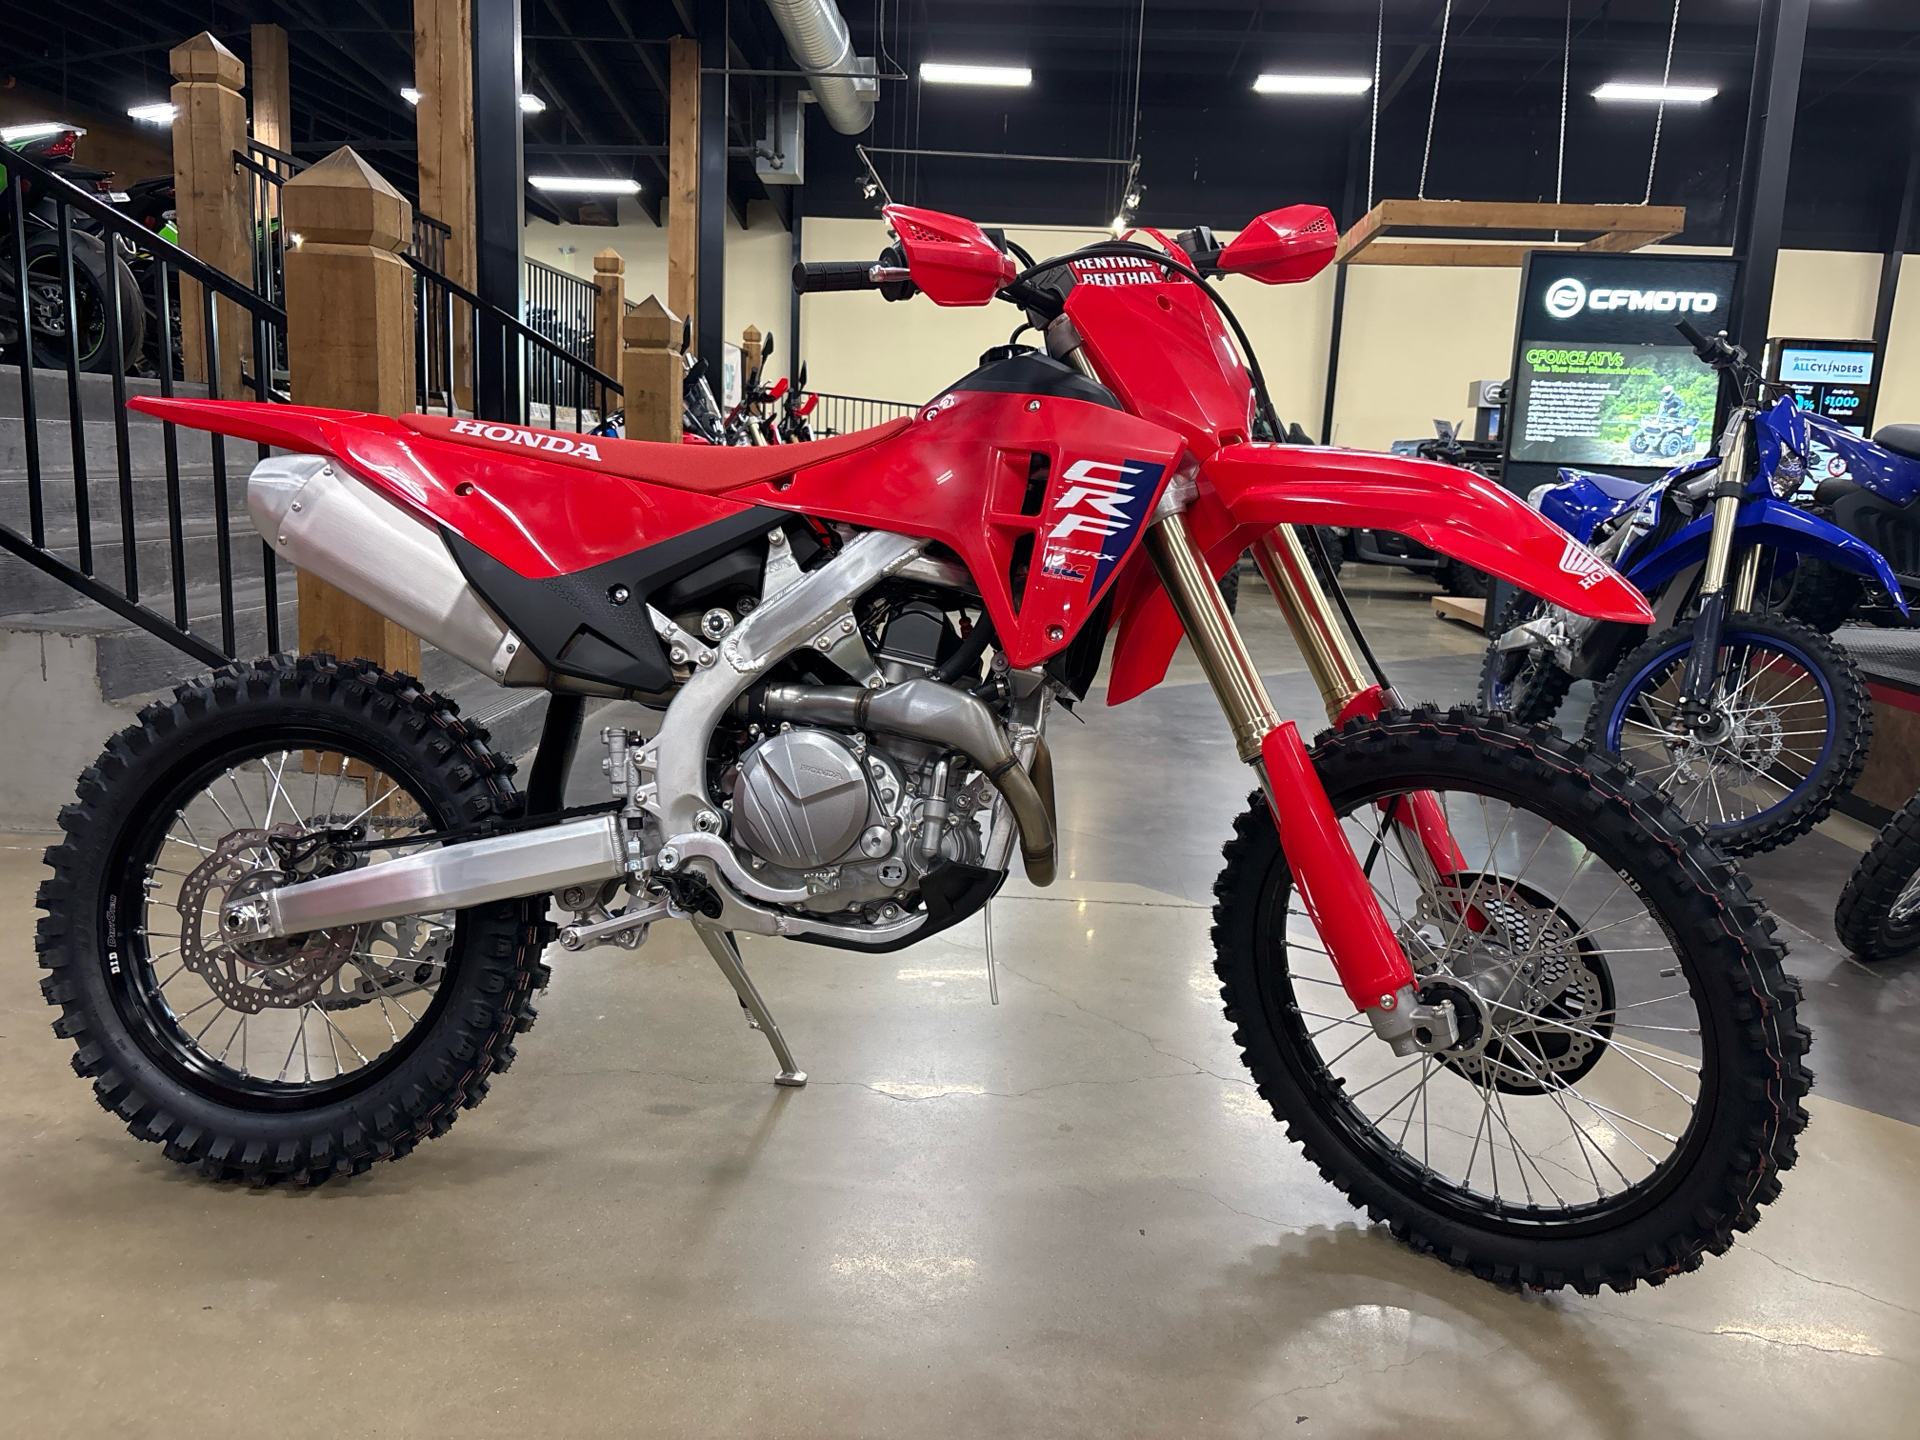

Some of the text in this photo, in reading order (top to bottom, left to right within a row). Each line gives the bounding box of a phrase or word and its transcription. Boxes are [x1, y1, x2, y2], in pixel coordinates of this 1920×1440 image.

[1074, 256, 1153, 269] RENTHAL
[1082, 271, 1163, 286] RENTHAL
[1588, 289, 1718, 312] CFMOTO
[1526, 349, 1625, 366] CFORCE ATVs
[450, 420, 602, 461] HONDA
[1047, 459, 1144, 538] CRF
[799, 764, 845, 782] HONDA
